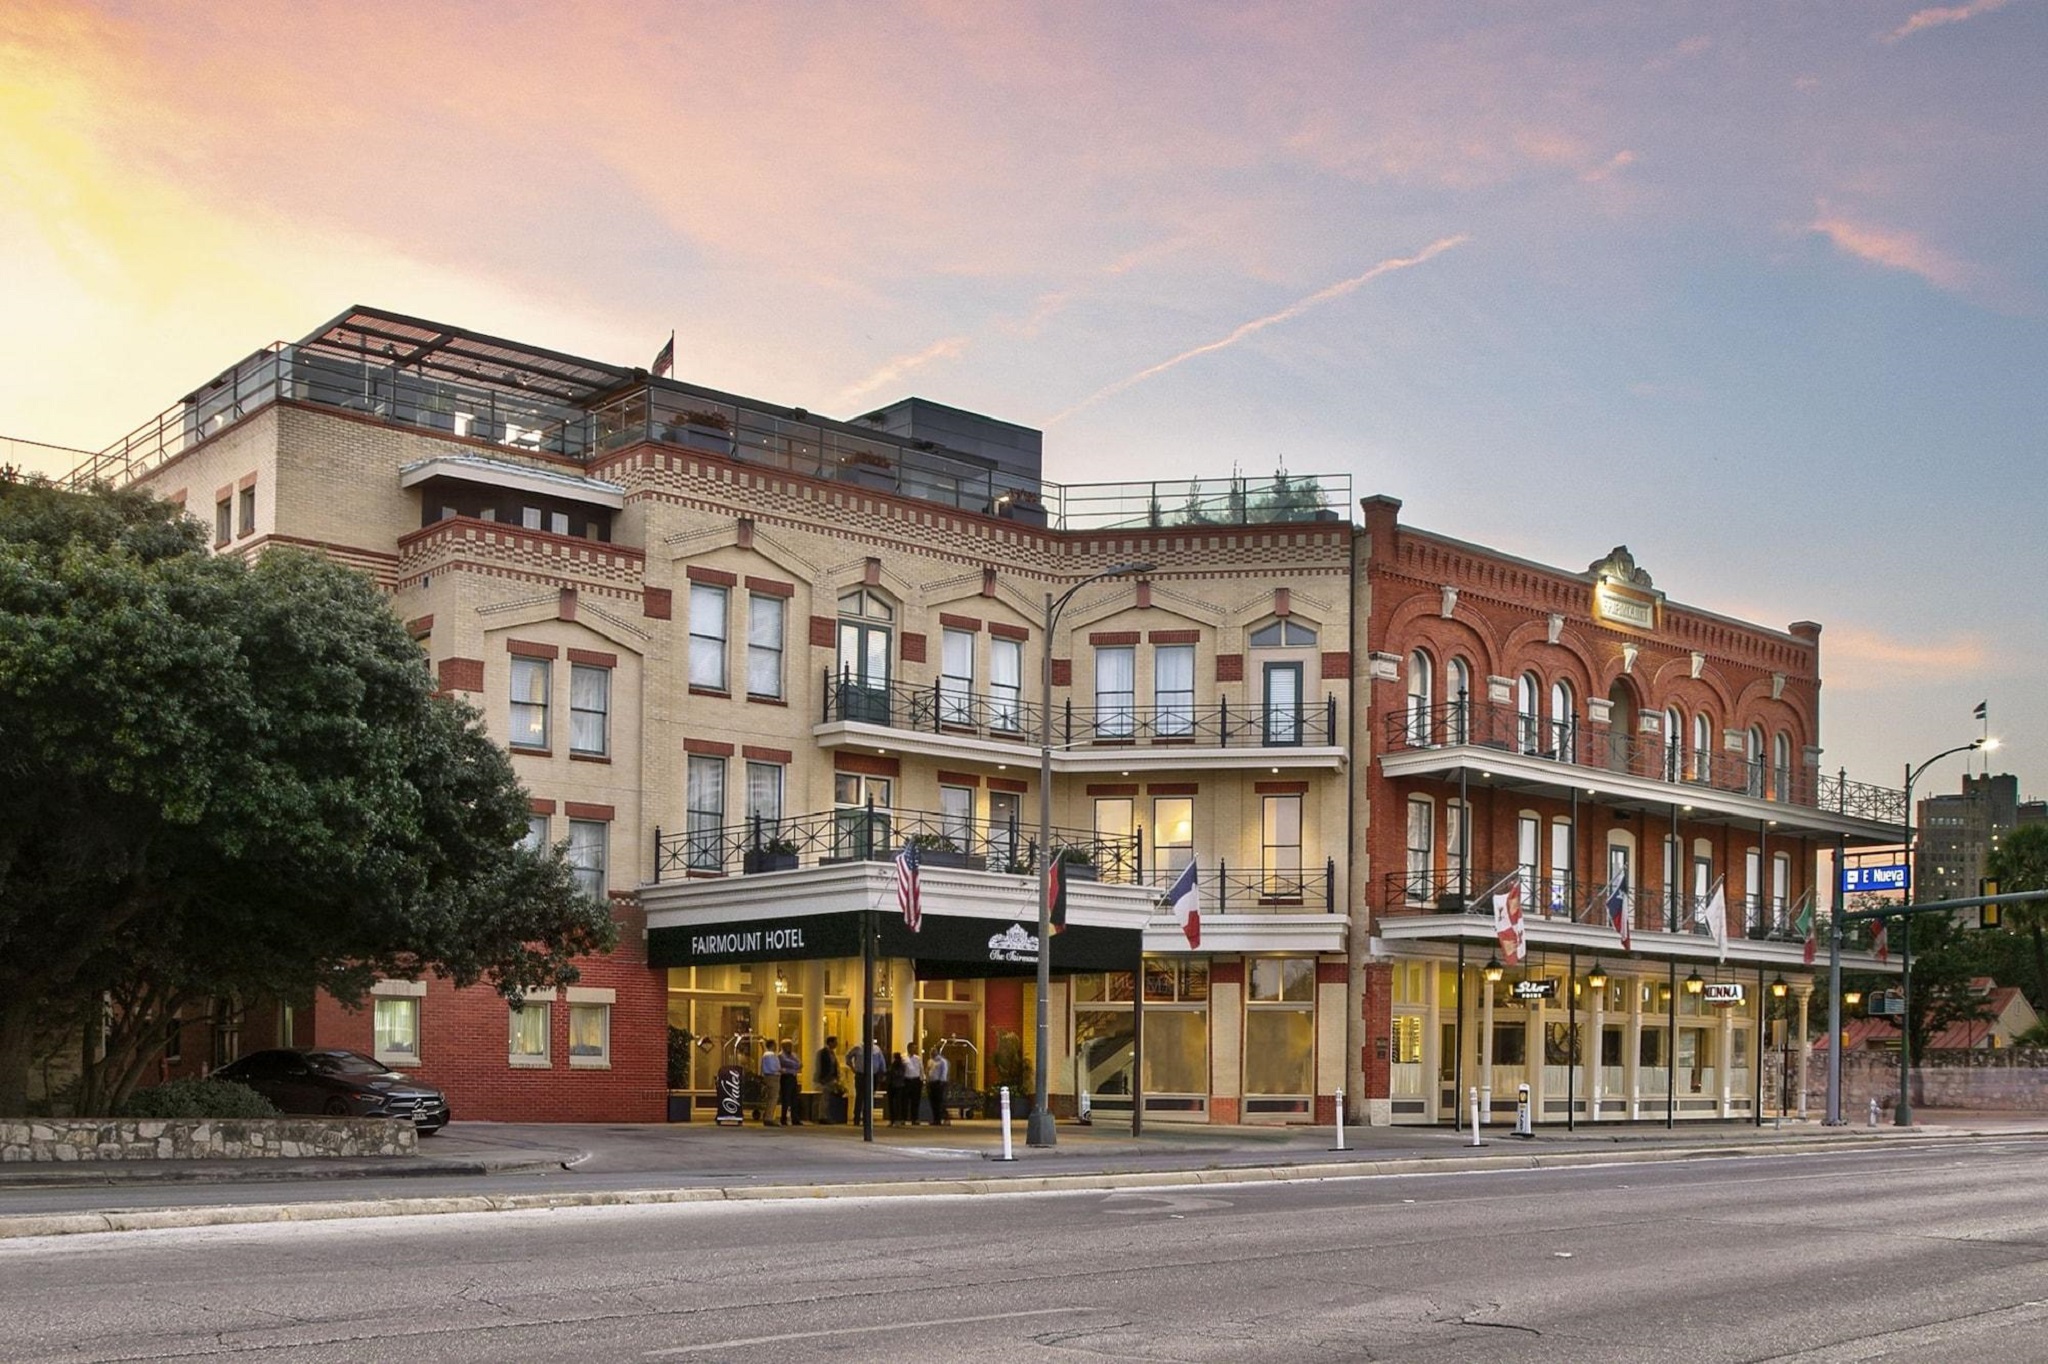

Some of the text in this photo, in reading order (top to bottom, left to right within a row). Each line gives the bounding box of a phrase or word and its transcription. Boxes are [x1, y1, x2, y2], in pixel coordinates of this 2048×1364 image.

[1863, 868, 1904, 883] E Nueva
[692, 928, 805, 955] FAIRMOUNT HOTEL
[989, 949, 1005, 960] The
[721, 1070, 740, 1114] Valet
